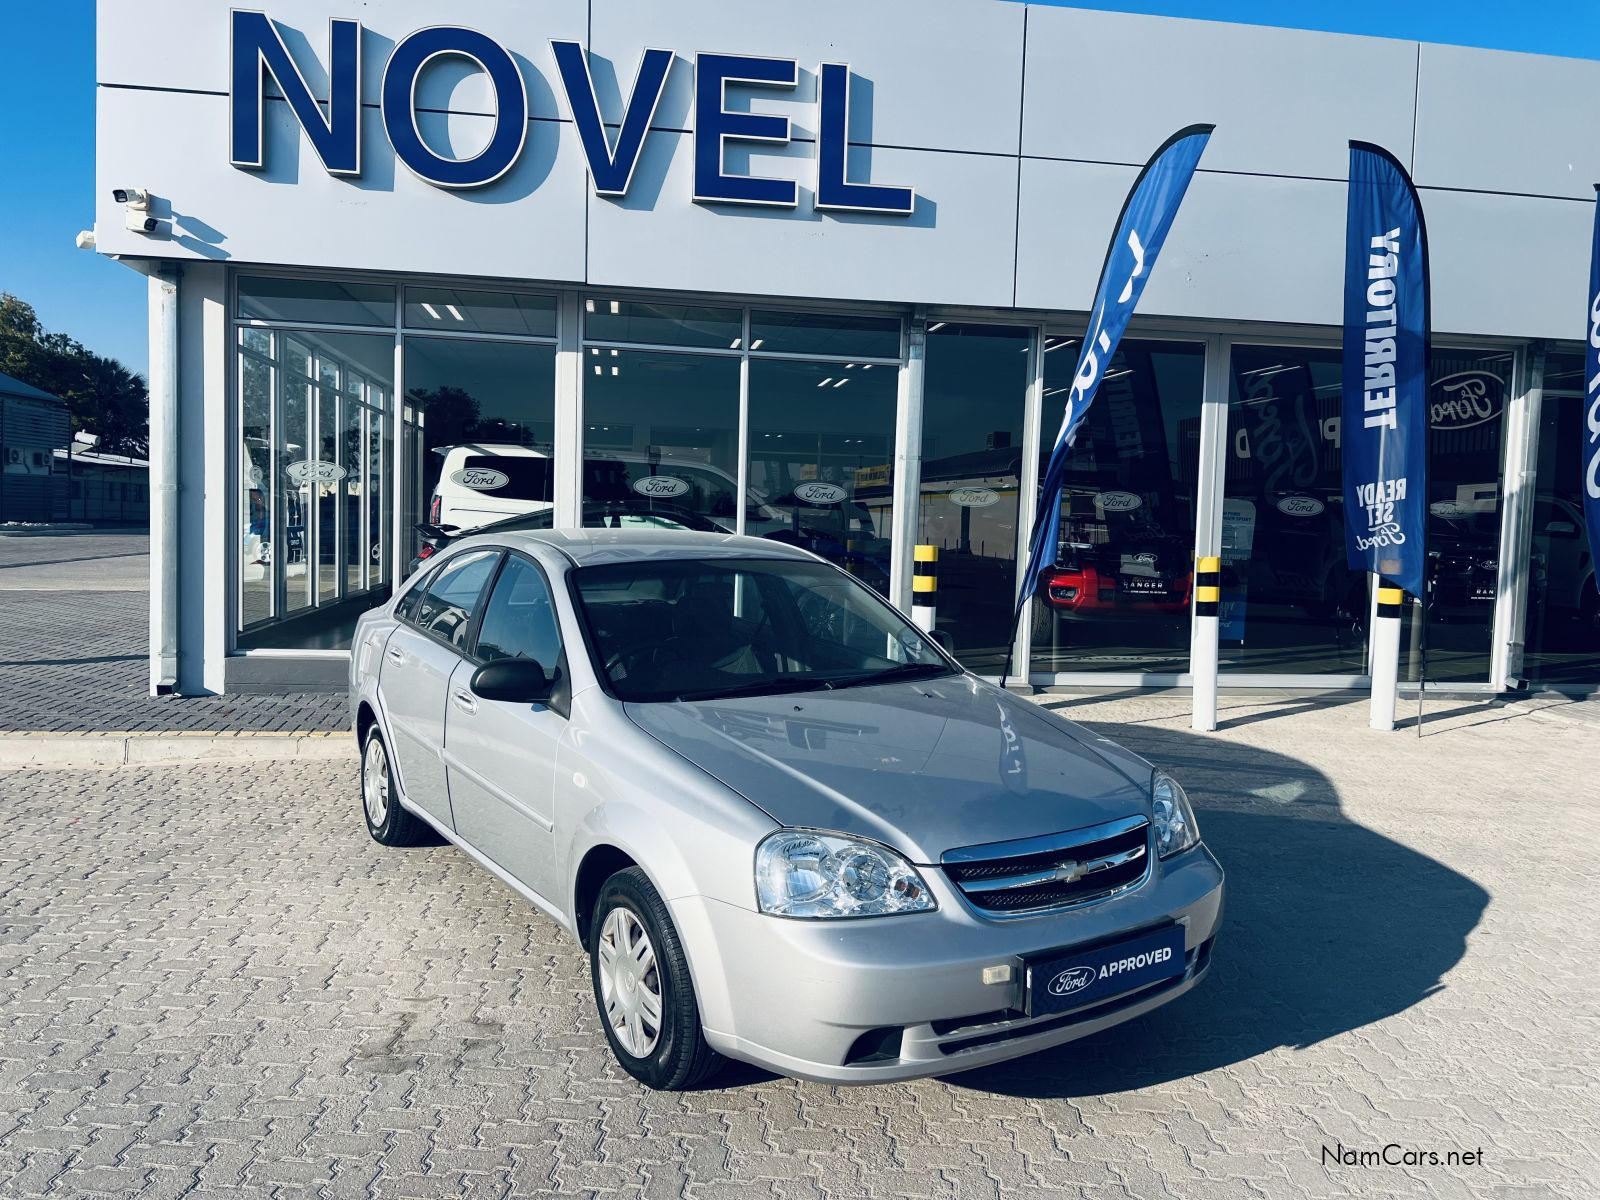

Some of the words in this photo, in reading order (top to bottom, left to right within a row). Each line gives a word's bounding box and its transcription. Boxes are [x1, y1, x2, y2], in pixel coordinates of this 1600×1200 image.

[230, 8, 915, 216] NOVEL
[462, 469, 498, 486] Ford
[645, 479, 677, 493] Ford
[805, 486, 835, 500] Ford
[959, 489, 988, 503] Ford
[1103, 494, 1132, 507] Ford
[1287, 499, 1314, 512] Ford
[1056, 970, 1087, 993] Ford
[1099, 947, 1172, 980] APPROVED
